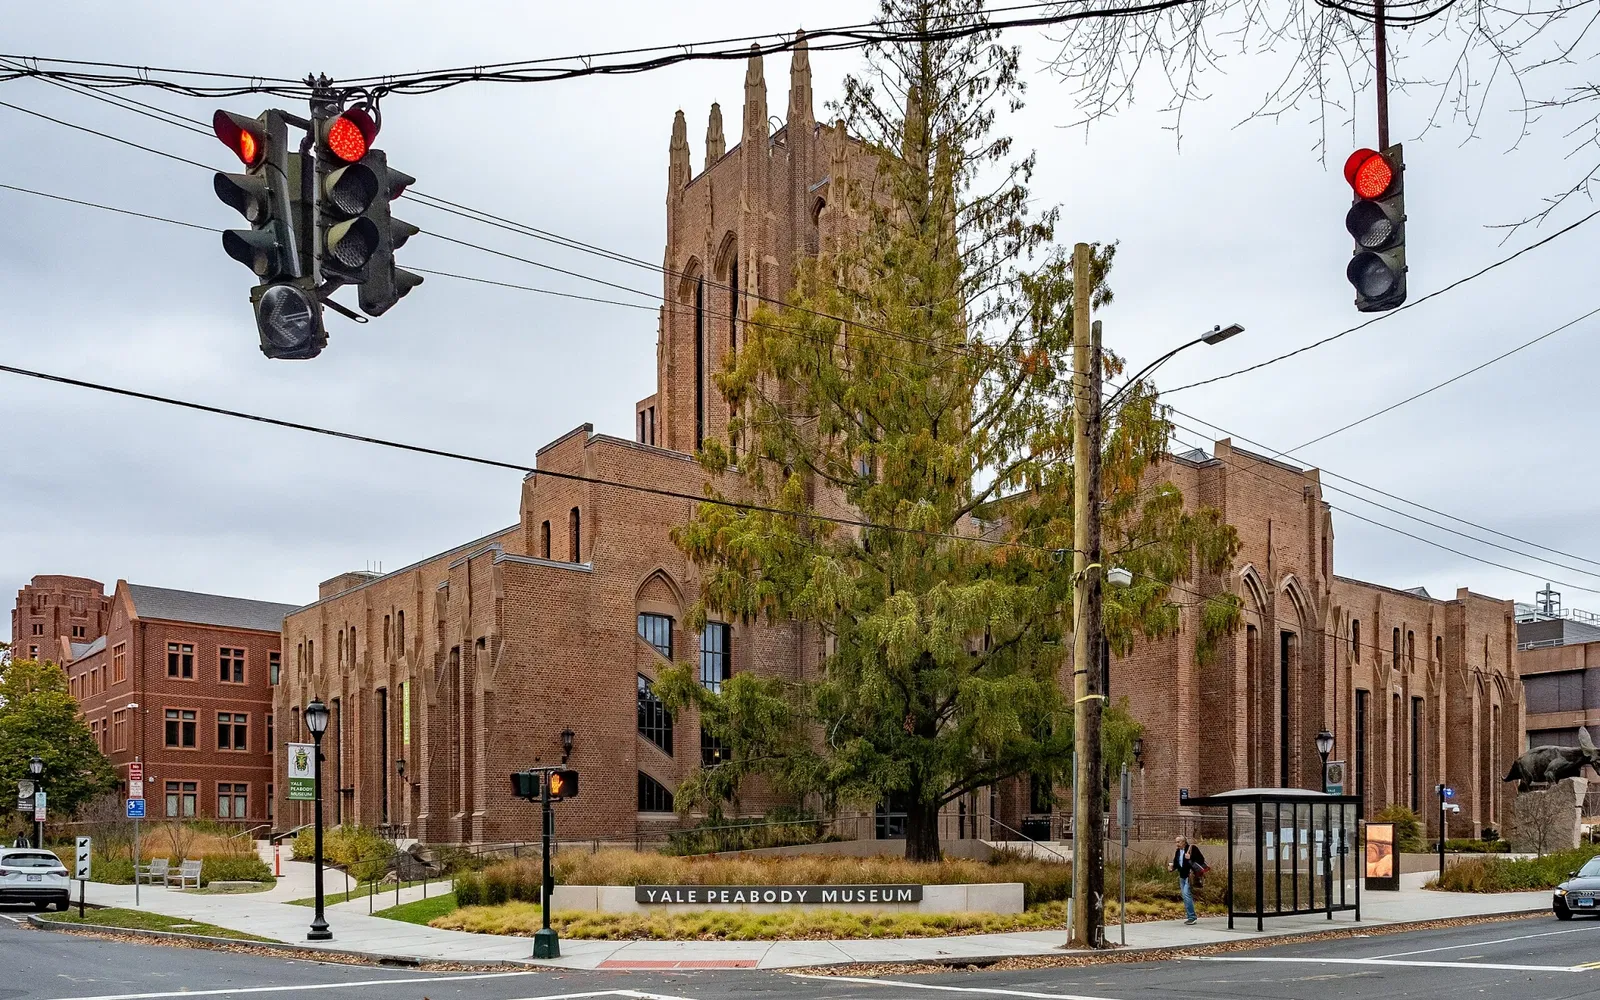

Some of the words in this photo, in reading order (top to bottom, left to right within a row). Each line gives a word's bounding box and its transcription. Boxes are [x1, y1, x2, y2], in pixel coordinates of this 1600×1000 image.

[646, 889, 697, 903] YALE
[707, 889, 808, 903] PEABODY
[821, 889, 912, 903] MUSEUM
